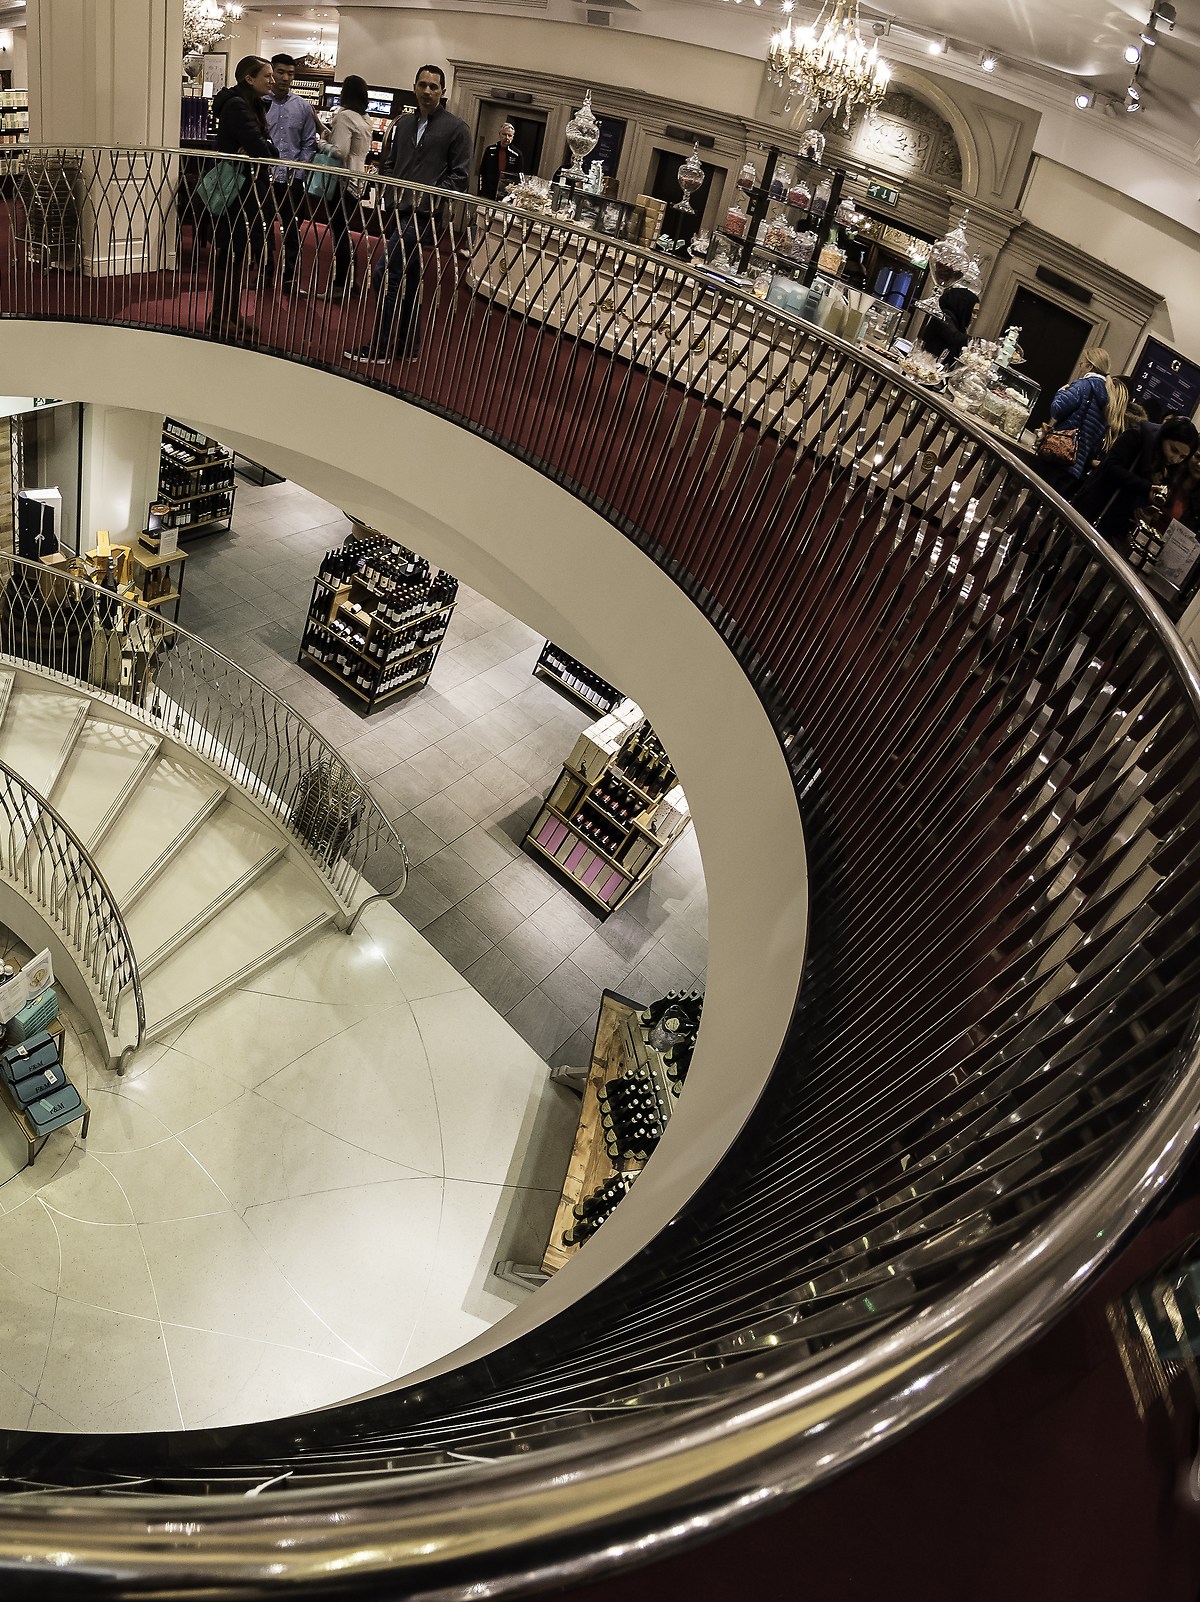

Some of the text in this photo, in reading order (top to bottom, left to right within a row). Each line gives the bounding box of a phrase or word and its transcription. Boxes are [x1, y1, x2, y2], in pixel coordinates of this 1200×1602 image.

[1147, 361, 1154, 369] 4
[1136, 384, 1143, 392] 2
[28, 1060, 44, 1072] F&M
